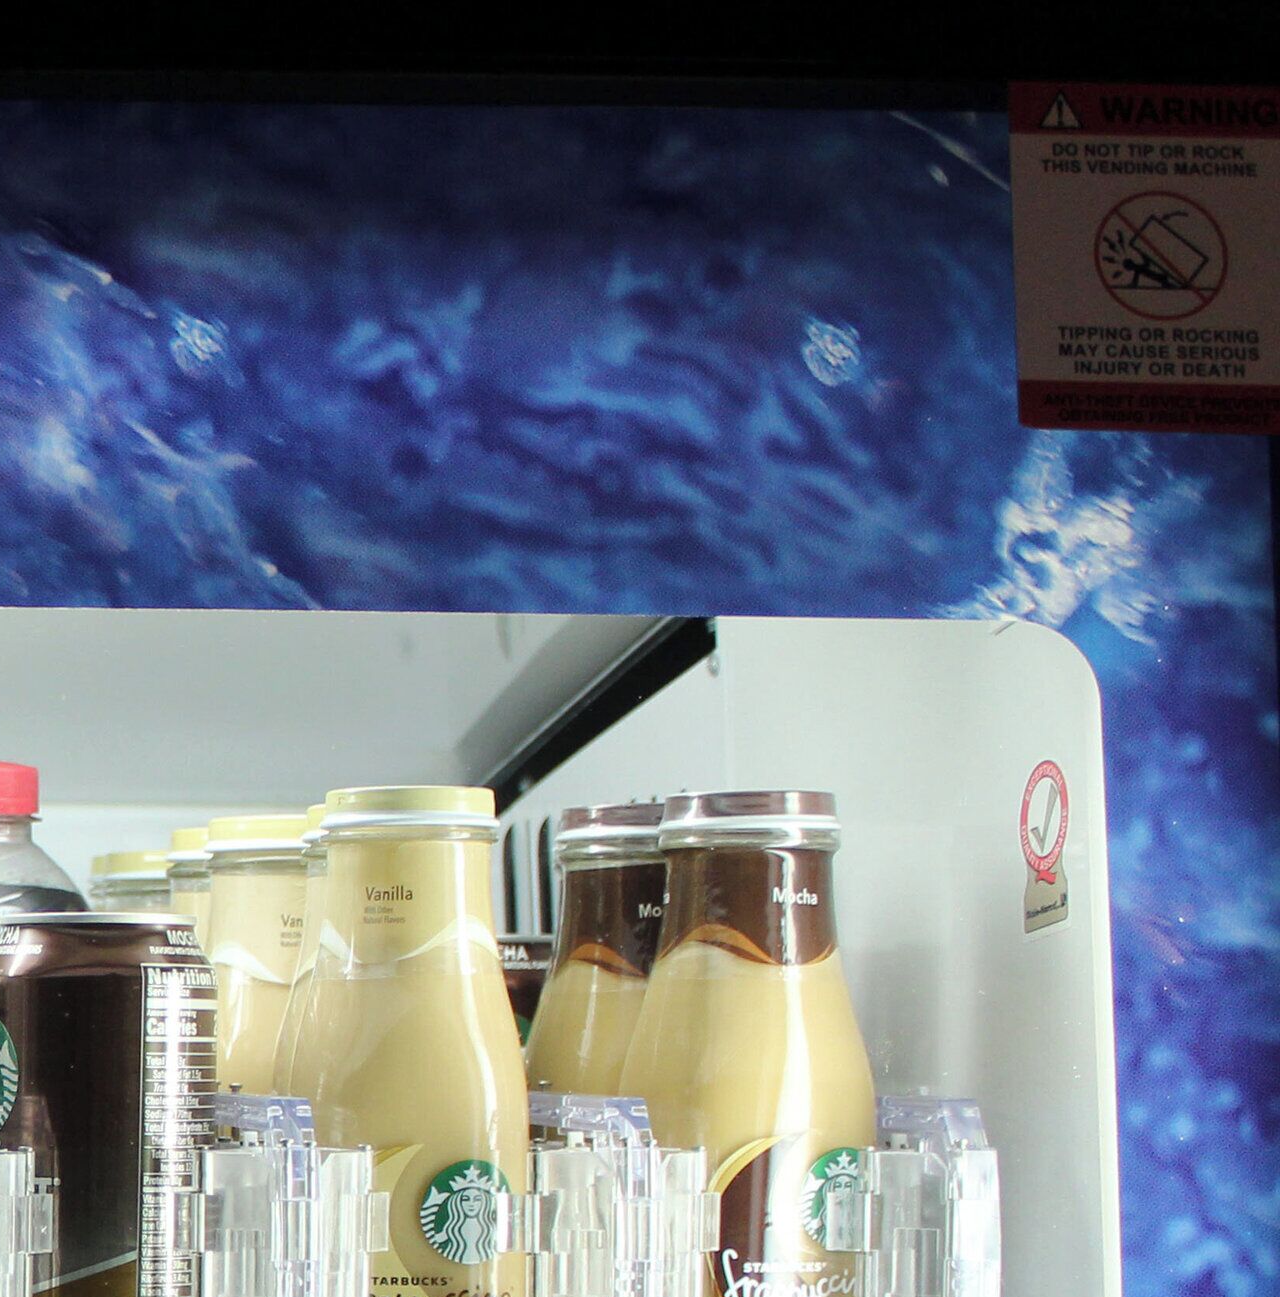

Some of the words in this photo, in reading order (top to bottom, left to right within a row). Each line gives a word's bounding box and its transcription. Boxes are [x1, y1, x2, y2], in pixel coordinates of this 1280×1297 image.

[1051, 143, 1078, 157] DO
[1084, 143, 1121, 158] NOT
[1127, 144, 1153, 158] TIP
[1160, 145, 1182, 159] OR
[1191, 146, 1245, 161] ROCK
[1041, 160, 1082, 174] THIS
[1087, 160, 1169, 175] VENDING
[1173, 161, 1258, 178] MACHINE
[1057, 326, 1132, 343] TIPPING
[1139, 327, 1166, 342] OR
[1171, 328, 1260, 345] ROCKING
[1057, 343, 1099, 358] MAY
[1105, 344, 1171, 359] CAUSE
[1176, 345, 1260, 362] SERIOUS
[1073, 360, 1141, 375] INJURY
[1148, 361, 1175, 376] OR
[1182, 362, 1246, 378] DEATH
[365, 885, 413, 901] Vanilla
[773, 888, 818, 905] Mocha
[371, 1276, 448, 1286] TARBUCKS
